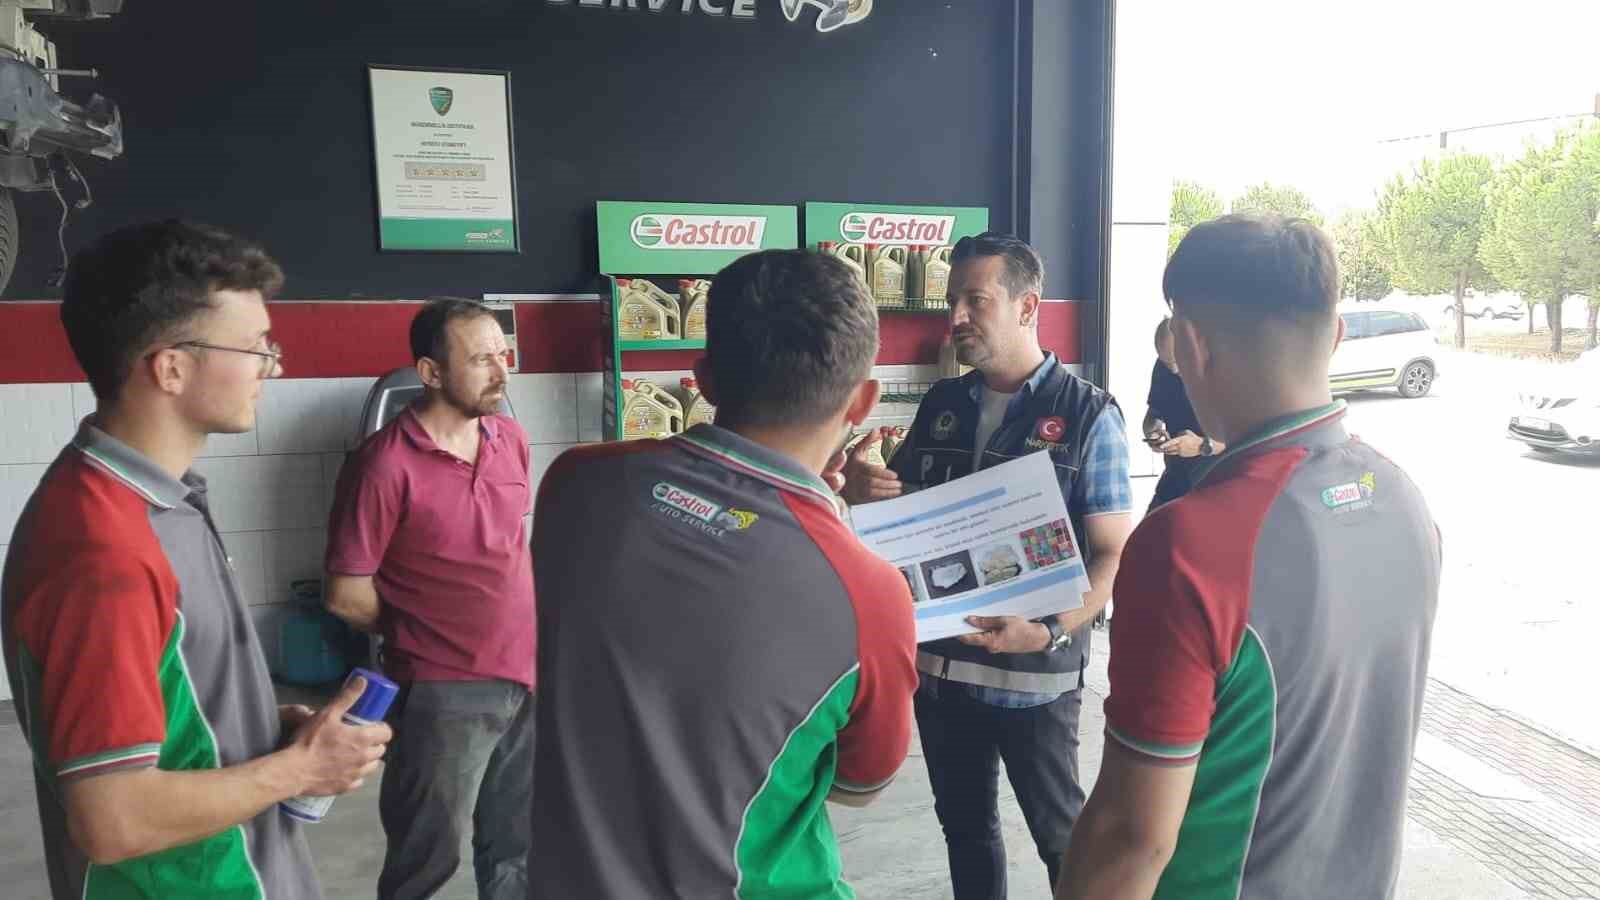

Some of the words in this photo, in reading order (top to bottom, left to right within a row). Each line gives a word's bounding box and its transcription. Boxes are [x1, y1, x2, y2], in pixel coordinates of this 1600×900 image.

[665, 218, 757, 245] Castrol
[868, 216, 946, 241] Castrol
[666, 489, 713, 517] Castrol
